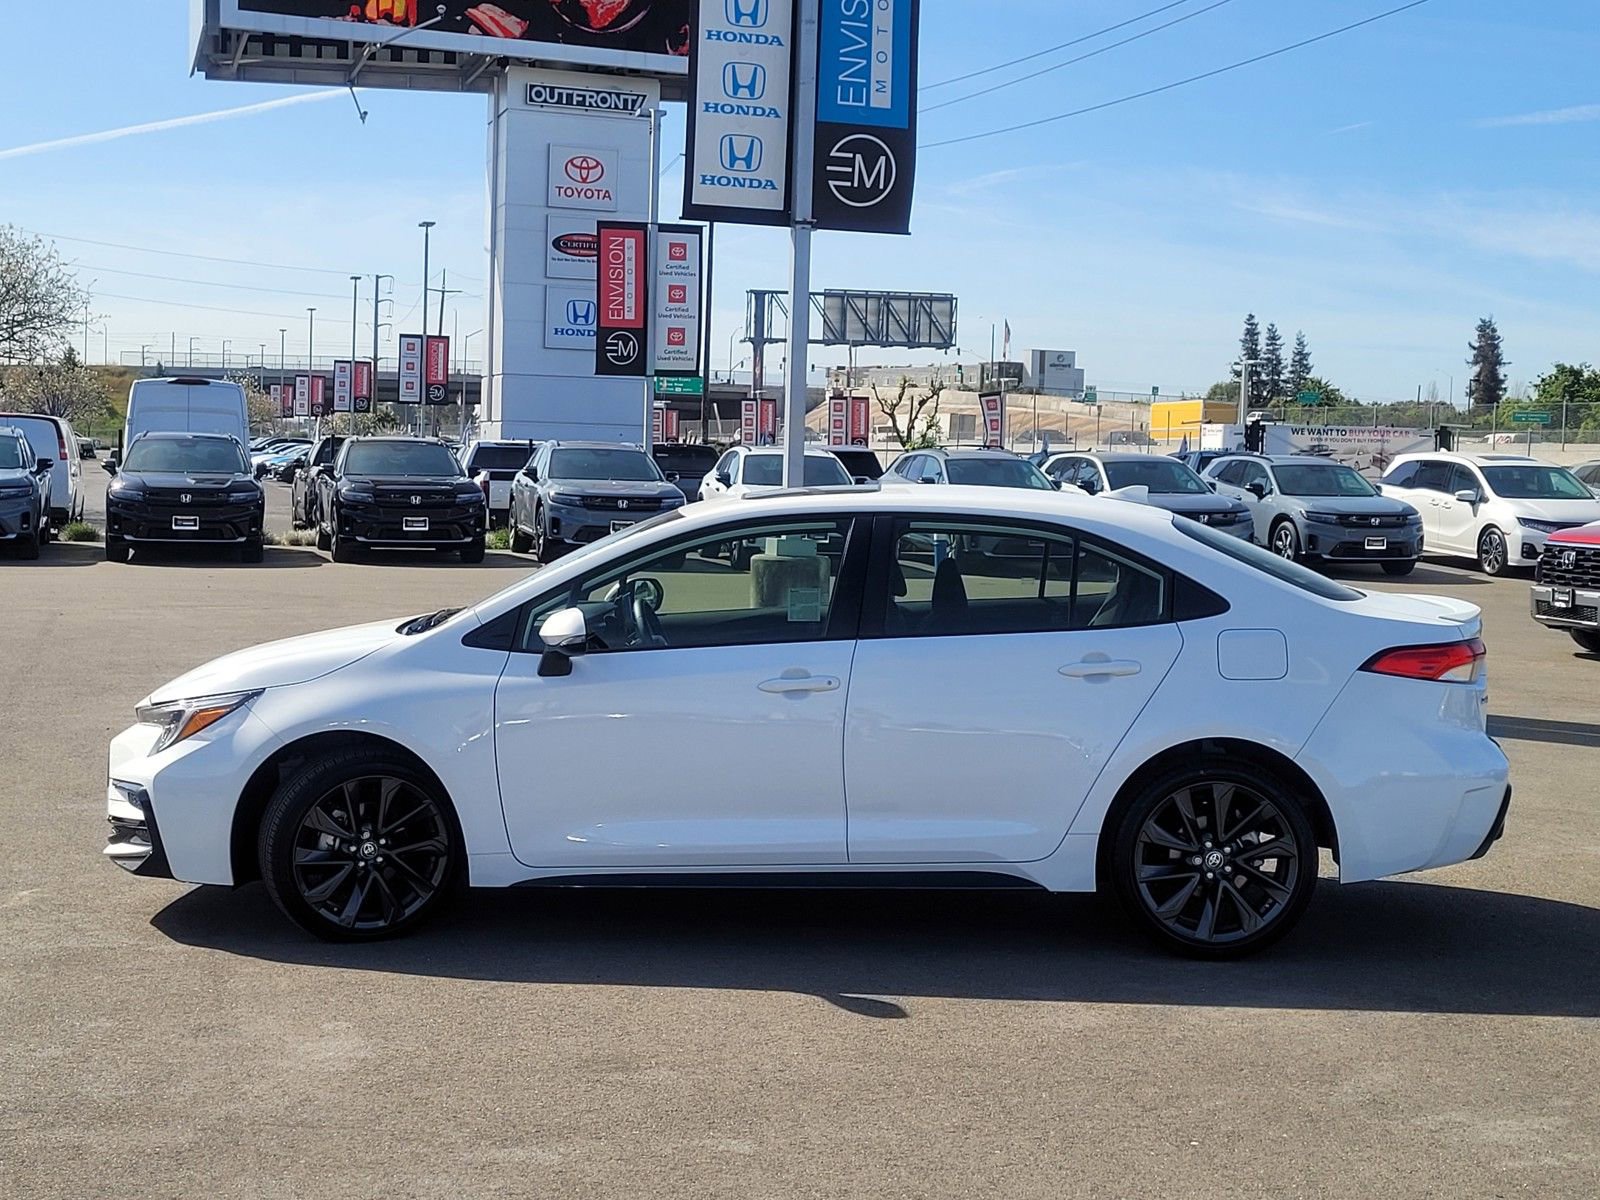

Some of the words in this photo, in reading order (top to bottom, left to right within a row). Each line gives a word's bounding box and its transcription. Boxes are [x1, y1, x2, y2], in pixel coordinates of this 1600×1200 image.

[705, 29, 784, 47] HONDA
[703, 101, 782, 119] HONDA
[699, 174, 778, 191] HONDA
[555, 185, 612, 201] TOYOTA
[608, 236, 624, 320] ENVISION
[430, 341, 439, 381] ENVISION
[1291, 427, 1306, 436] WE
[1307, 428, 1334, 437] WANT
[1335, 428, 1347, 437] TO
[1348, 429, 1366, 438] BUY
[1367, 429, 1391, 438] YOUR
